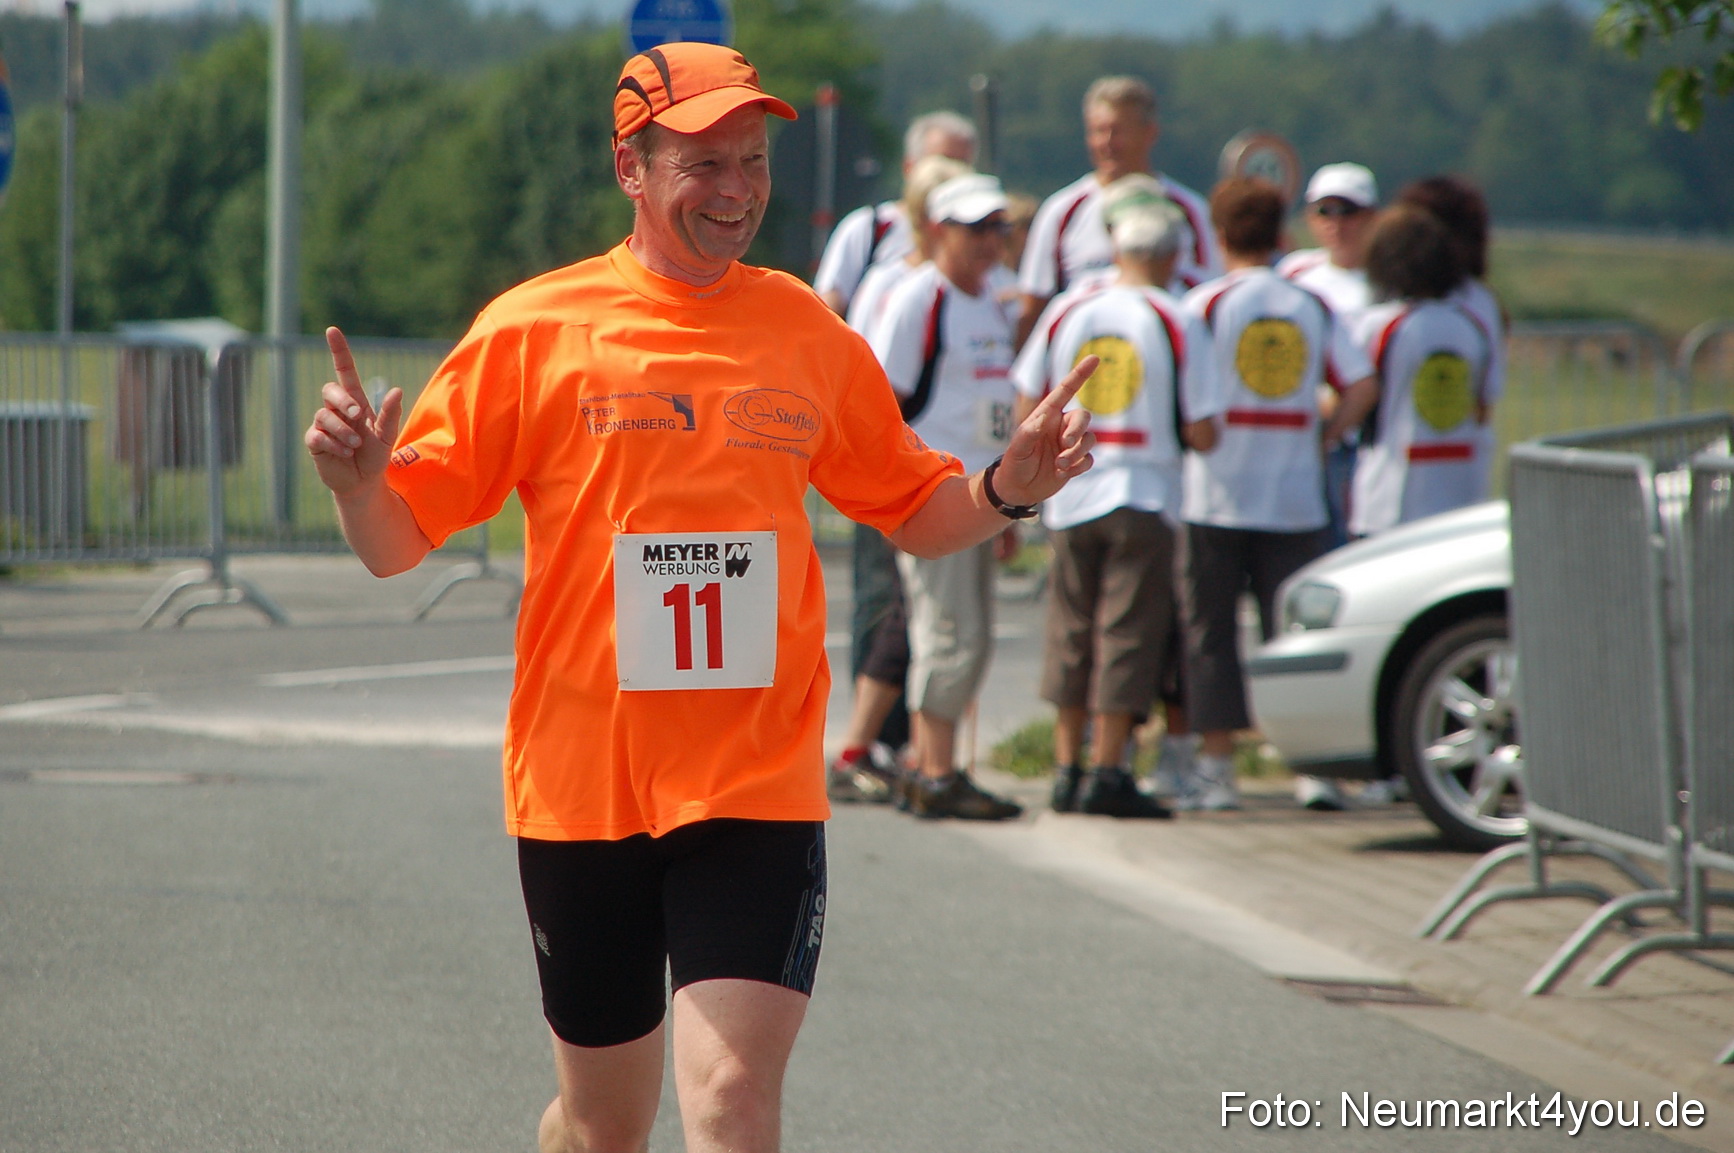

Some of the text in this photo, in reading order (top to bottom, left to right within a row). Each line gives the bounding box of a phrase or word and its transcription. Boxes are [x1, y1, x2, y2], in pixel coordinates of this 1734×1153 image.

[581, 406, 616, 419] PETER
[586, 418, 677, 435] KRONENBERG
[726, 438, 765, 450] Florale
[643, 543, 720, 562] MEYER
[643, 562, 721, 576] WERBUNG
[663, 582, 724, 671] 11
[808, 894, 825, 948] TAO
